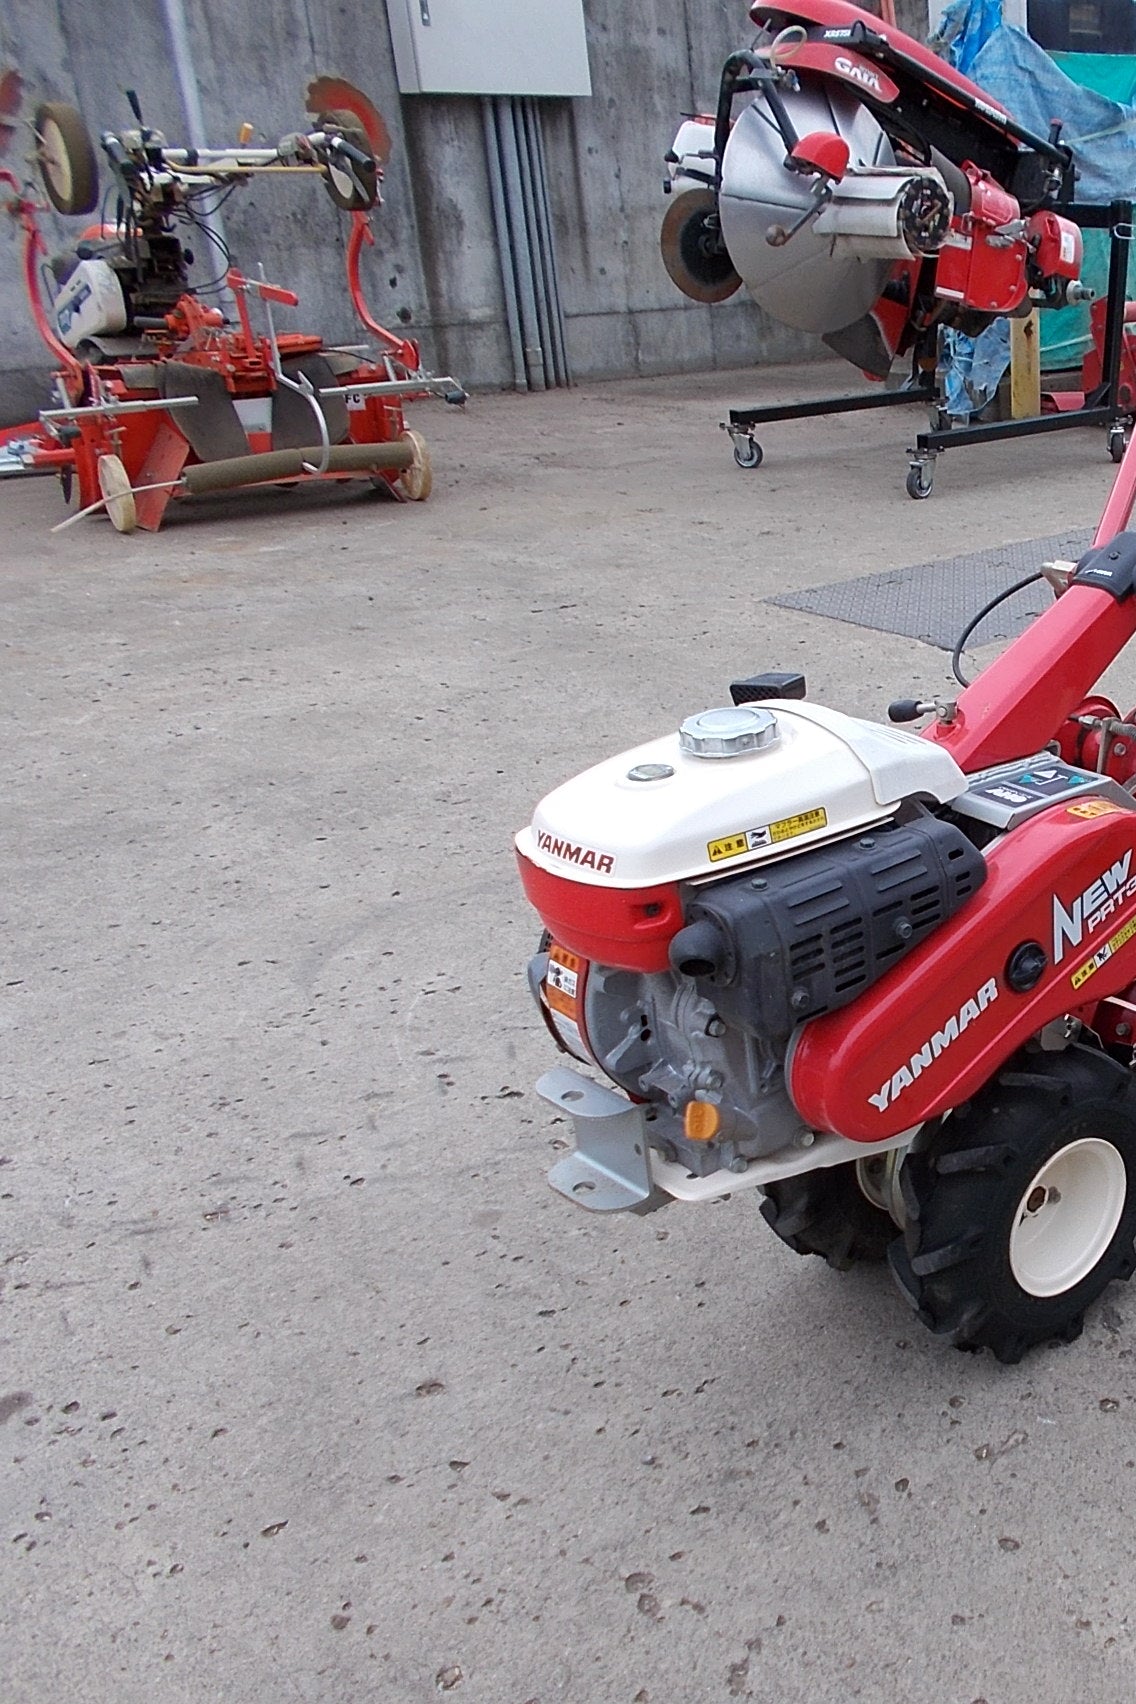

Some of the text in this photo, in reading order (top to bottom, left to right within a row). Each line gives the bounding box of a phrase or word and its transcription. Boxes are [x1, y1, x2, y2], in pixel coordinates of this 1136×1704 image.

[537, 829, 615, 874] YANMAR
[1053, 848, 1133, 966] NEW
[867, 977, 999, 1113] YANMAR
